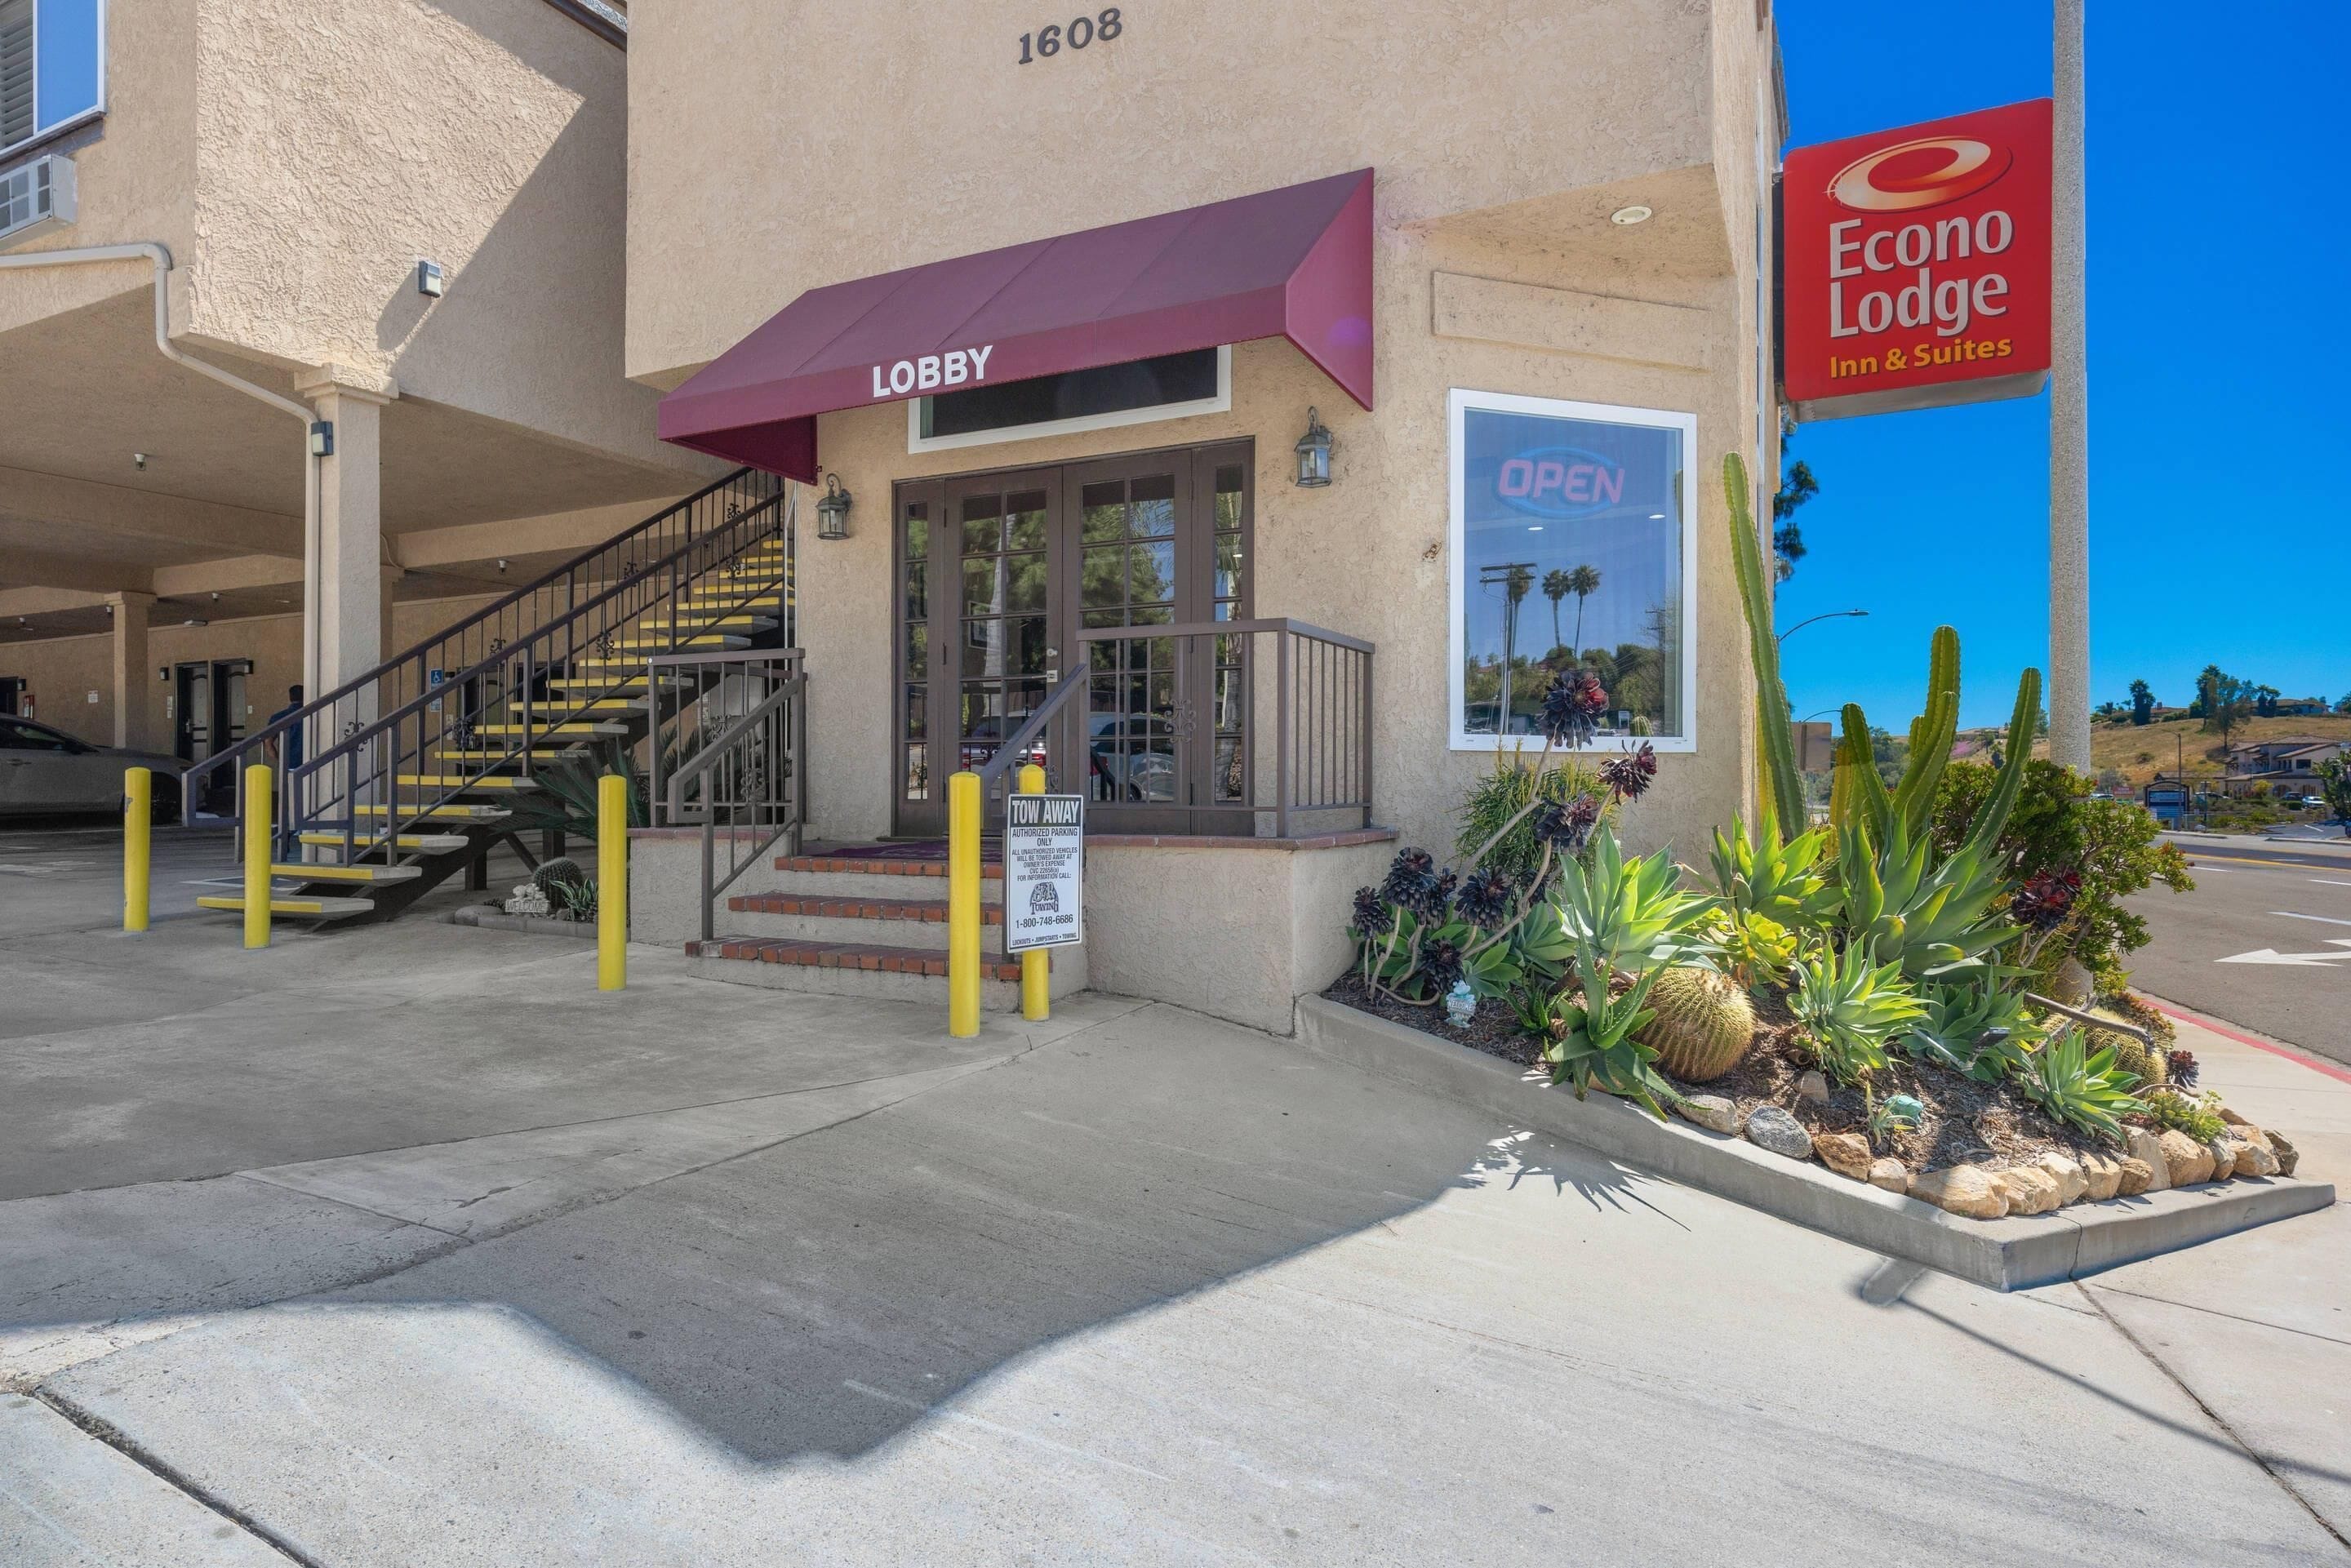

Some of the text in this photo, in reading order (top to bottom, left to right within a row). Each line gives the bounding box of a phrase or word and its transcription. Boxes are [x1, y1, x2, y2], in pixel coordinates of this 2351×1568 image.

[1019, 7, 1122, 64] 1608
[1829, 210, 2013, 278] Econo
[1830, 267, 2008, 338] Lodge
[873, 345, 993, 398] LOBBY
[1830, 339, 2011, 379] Inn & Suites
[1499, 459, 1625, 504] OPEN
[1012, 800, 1079, 824] TOW AWAY
[1012, 828, 1078, 837] AUTHORIZED PARKING
[1037, 837, 1052, 846] ONLY
[1027, 873, 1058, 881] INFORMATION
[507, 900, 547, 912] WELCOME
[1016, 914, 1073, 929] 1-800-748-6686
